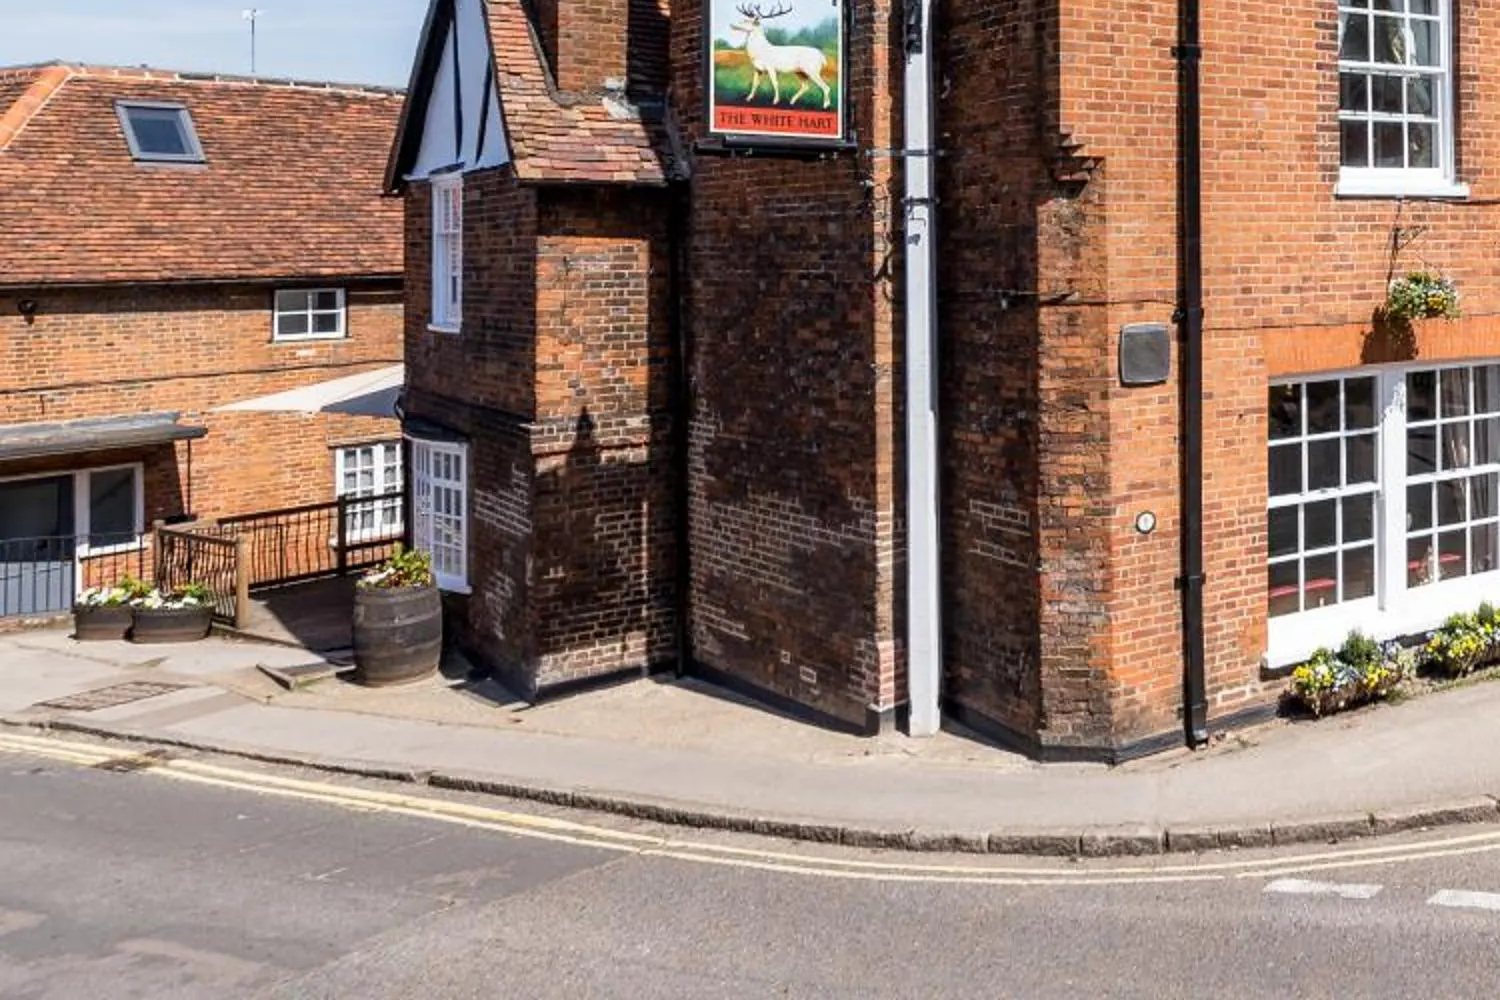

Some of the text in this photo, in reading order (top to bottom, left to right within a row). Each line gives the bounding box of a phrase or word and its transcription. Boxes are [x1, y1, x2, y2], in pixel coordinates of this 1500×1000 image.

[720, 111, 832, 129] THE WHITE HART
